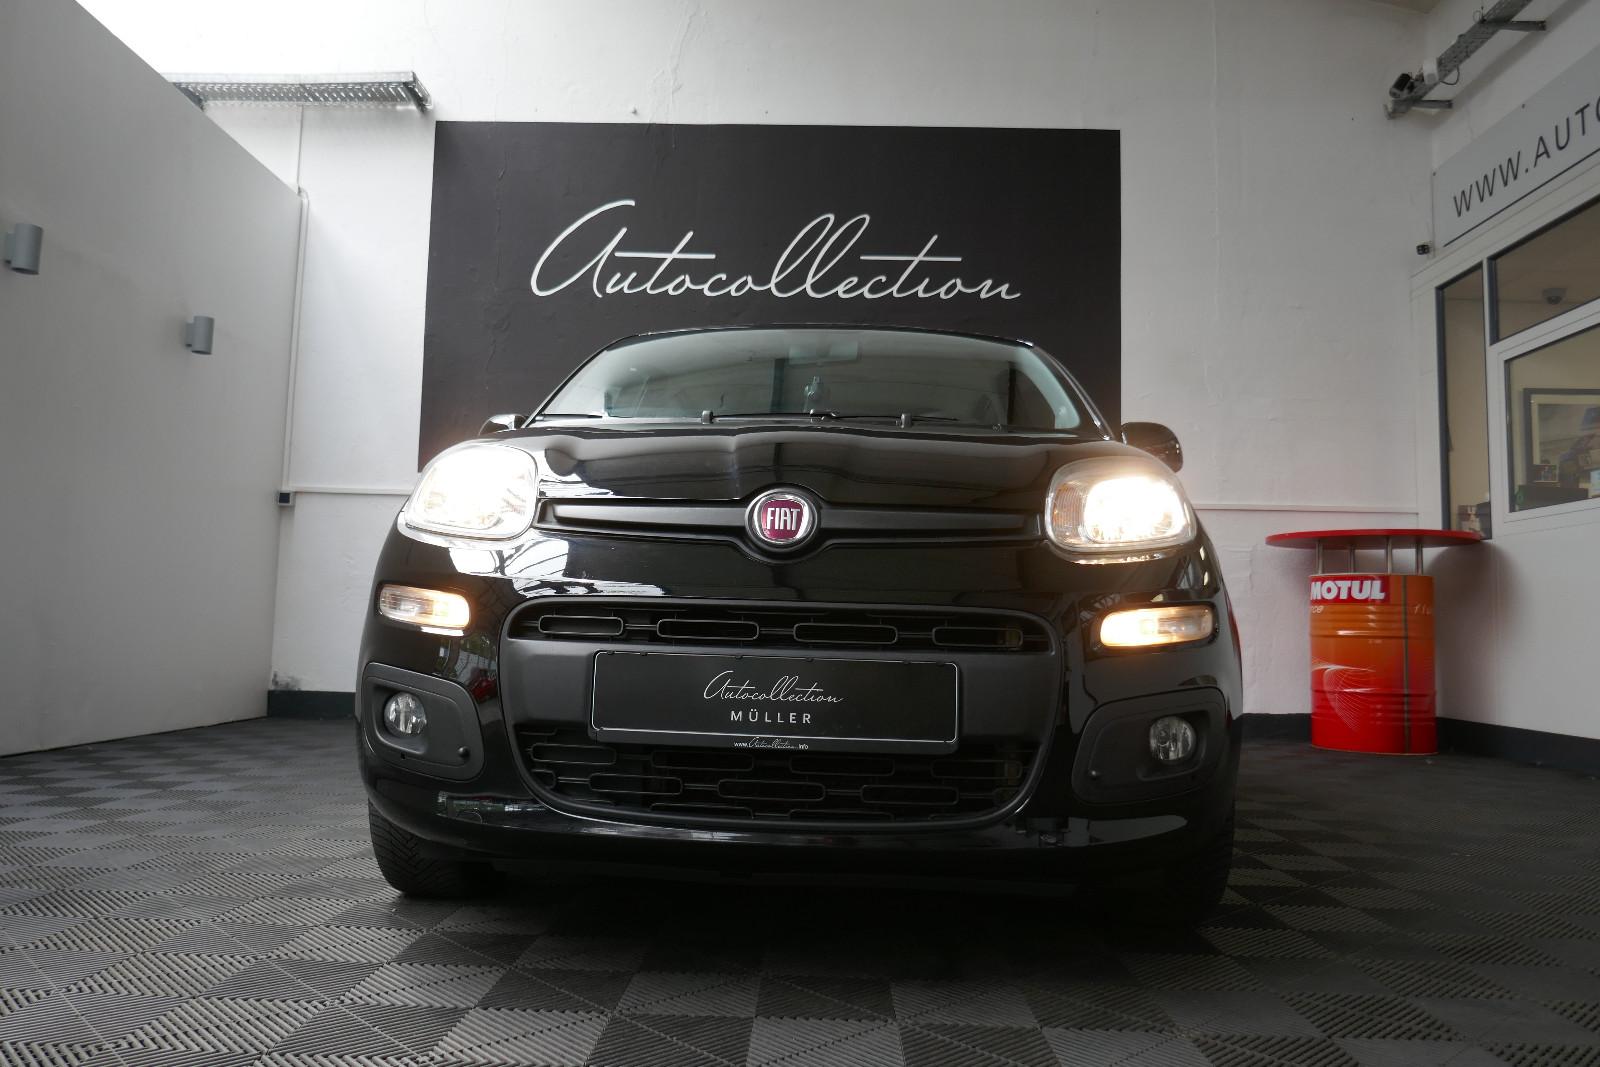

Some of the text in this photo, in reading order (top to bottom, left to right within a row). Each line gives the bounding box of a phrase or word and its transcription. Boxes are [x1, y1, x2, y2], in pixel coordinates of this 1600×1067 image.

[1453, 95, 1600, 217] WWW.AUT
[530, 199, 1021, 299] Autocollection
[766, 507, 801, 531] FIAT
[1310, 580, 1386, 600] MOTUL
[703, 670, 844, 703] Autocollection
[730, 708, 812, 724] MÜLLER
